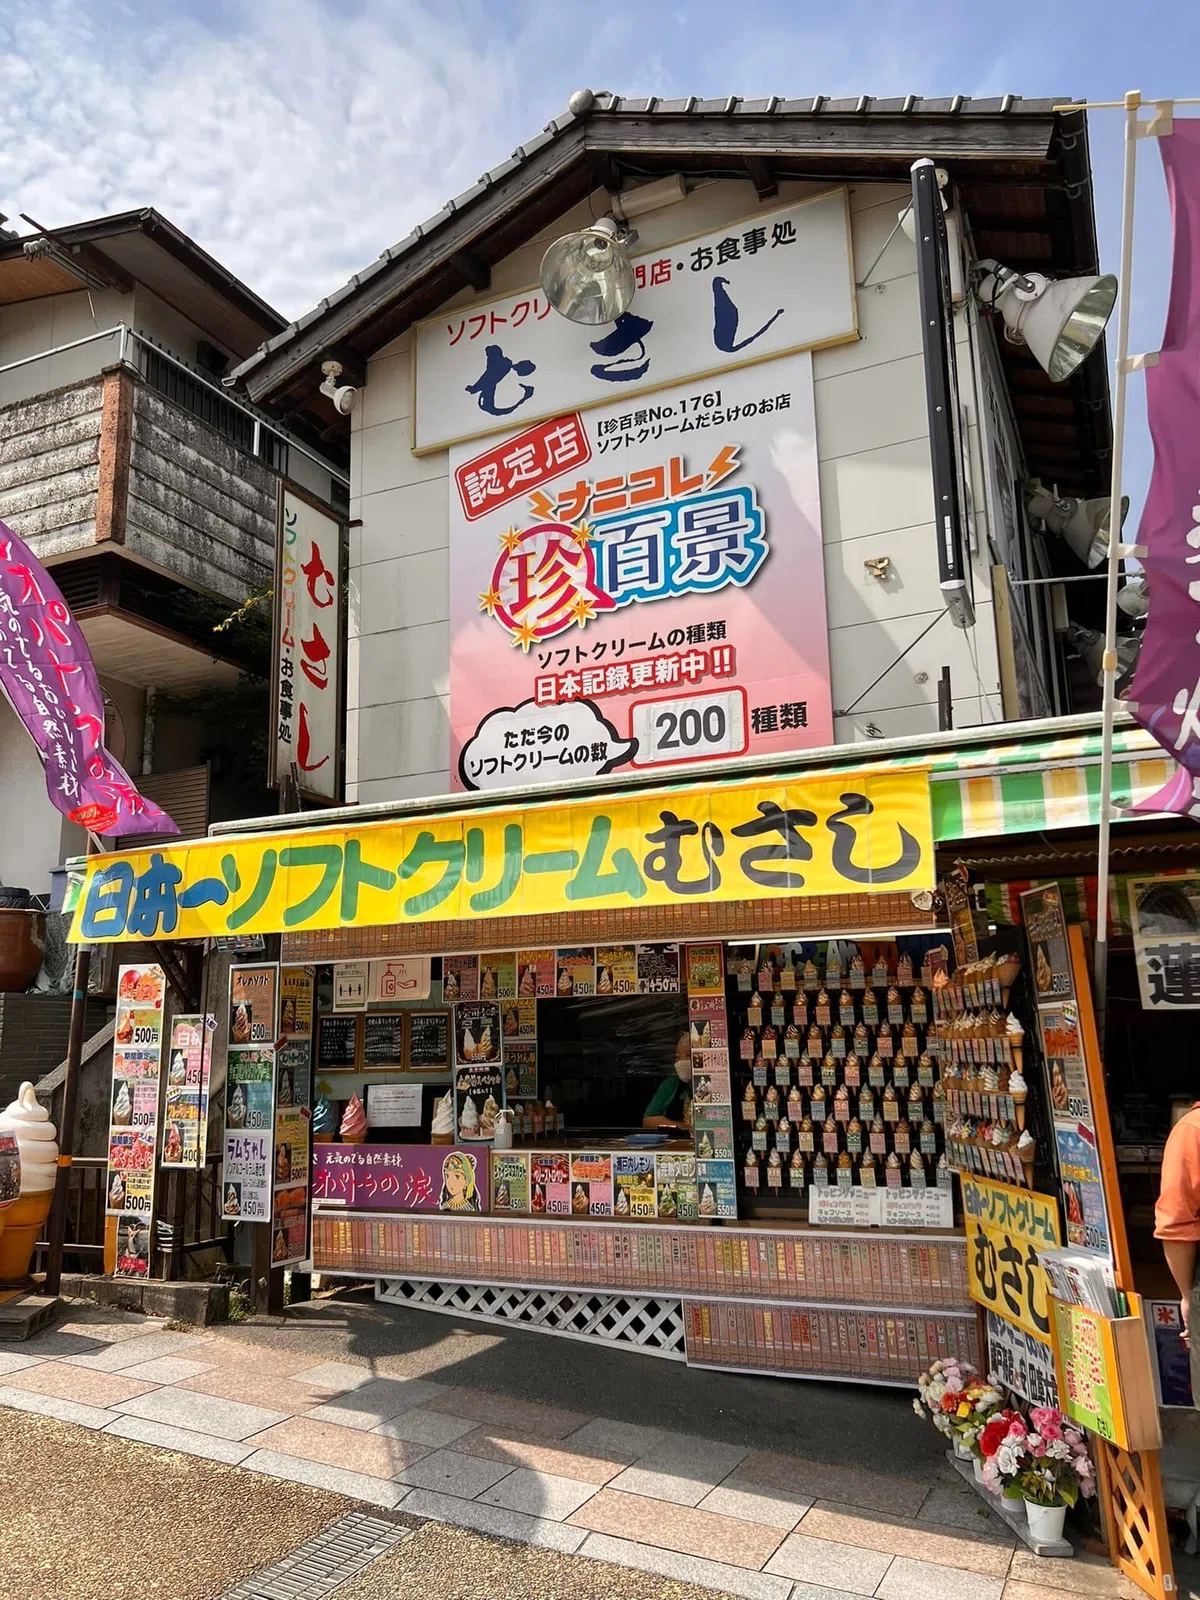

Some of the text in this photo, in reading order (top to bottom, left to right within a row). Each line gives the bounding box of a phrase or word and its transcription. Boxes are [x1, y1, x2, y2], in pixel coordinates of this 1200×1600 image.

[465, 275, 785, 417] むさし
[597, 391, 722, 437] 【珍百景No.176】
[597, 393, 792, 454] ソフトクリームだらけのお店
[464, 421, 578, 508] 認定店
[556, 456, 704, 520] ナニコレ
[508, 499, 754, 629] 珍百景
[278, 507, 297, 744] ソフトクリーム・お食事処
[297, 541, 335, 771] むさし
[537, 620, 727, 669] ソフトクリームの種類
[655, 704, 726, 751] 200
[751, 702, 808, 735] 種類
[503, 723, 570, 749] ただ今の
[470, 741, 608, 778] ソフトクリームの数
[238, 973, 270, 987] オレのソフト
[613, 979, 635, 993] 450円
[134, 1027, 159, 1043] 500円
[133, 1113, 155, 1126] 500円
[228, 1138, 266, 1161] ラムちゃん
[616, 1156, 651, 1172] 瀬戸内レモン
[126, 1196, 151, 1211] 500円
[547, 1200, 569, 1213] 450円
[818, 1188, 877, 1199] トッピングメニュー
[886, 1189, 947, 1200] トッピングメニュー
[243, 1201, 264, 1216] 450円
[590, 1202, 611, 1215] 450円
[631, 1203, 655, 1216] 450円
[974, 1223, 1051, 1334] むさし
[858, 1318, 867, 1348] しょうゆ
[886, 1319, 895, 1346] カレー
